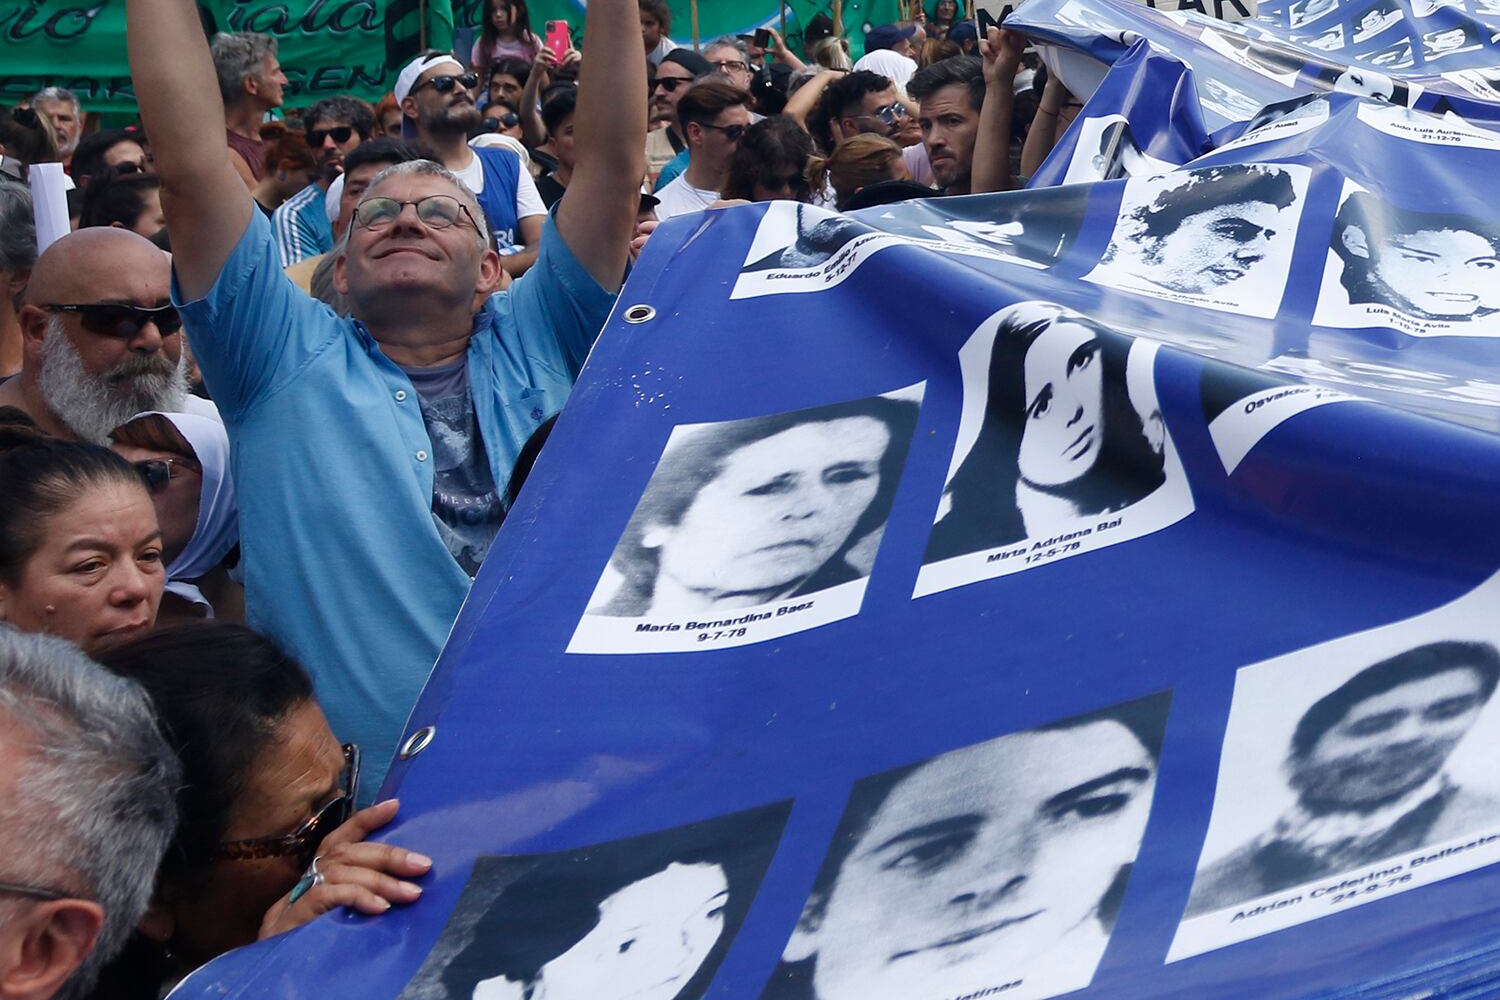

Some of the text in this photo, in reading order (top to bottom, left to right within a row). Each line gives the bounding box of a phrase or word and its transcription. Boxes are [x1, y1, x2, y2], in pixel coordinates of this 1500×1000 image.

[1413, 126, 1434, 134] Luis
[767, 270, 821, 281] Eduardo
[1366, 306, 1390, 314] Luis
[986, 547, 1027, 564] Mirta
[1031, 528, 1093, 551] Adriana
[1024, 541, 1081, 564] 12-5-78
[635, 600, 816, 633] María Bernardina Baez
[697, 627, 748, 643] 9-7-78
[1309, 866, 1403, 898] Ceferino
